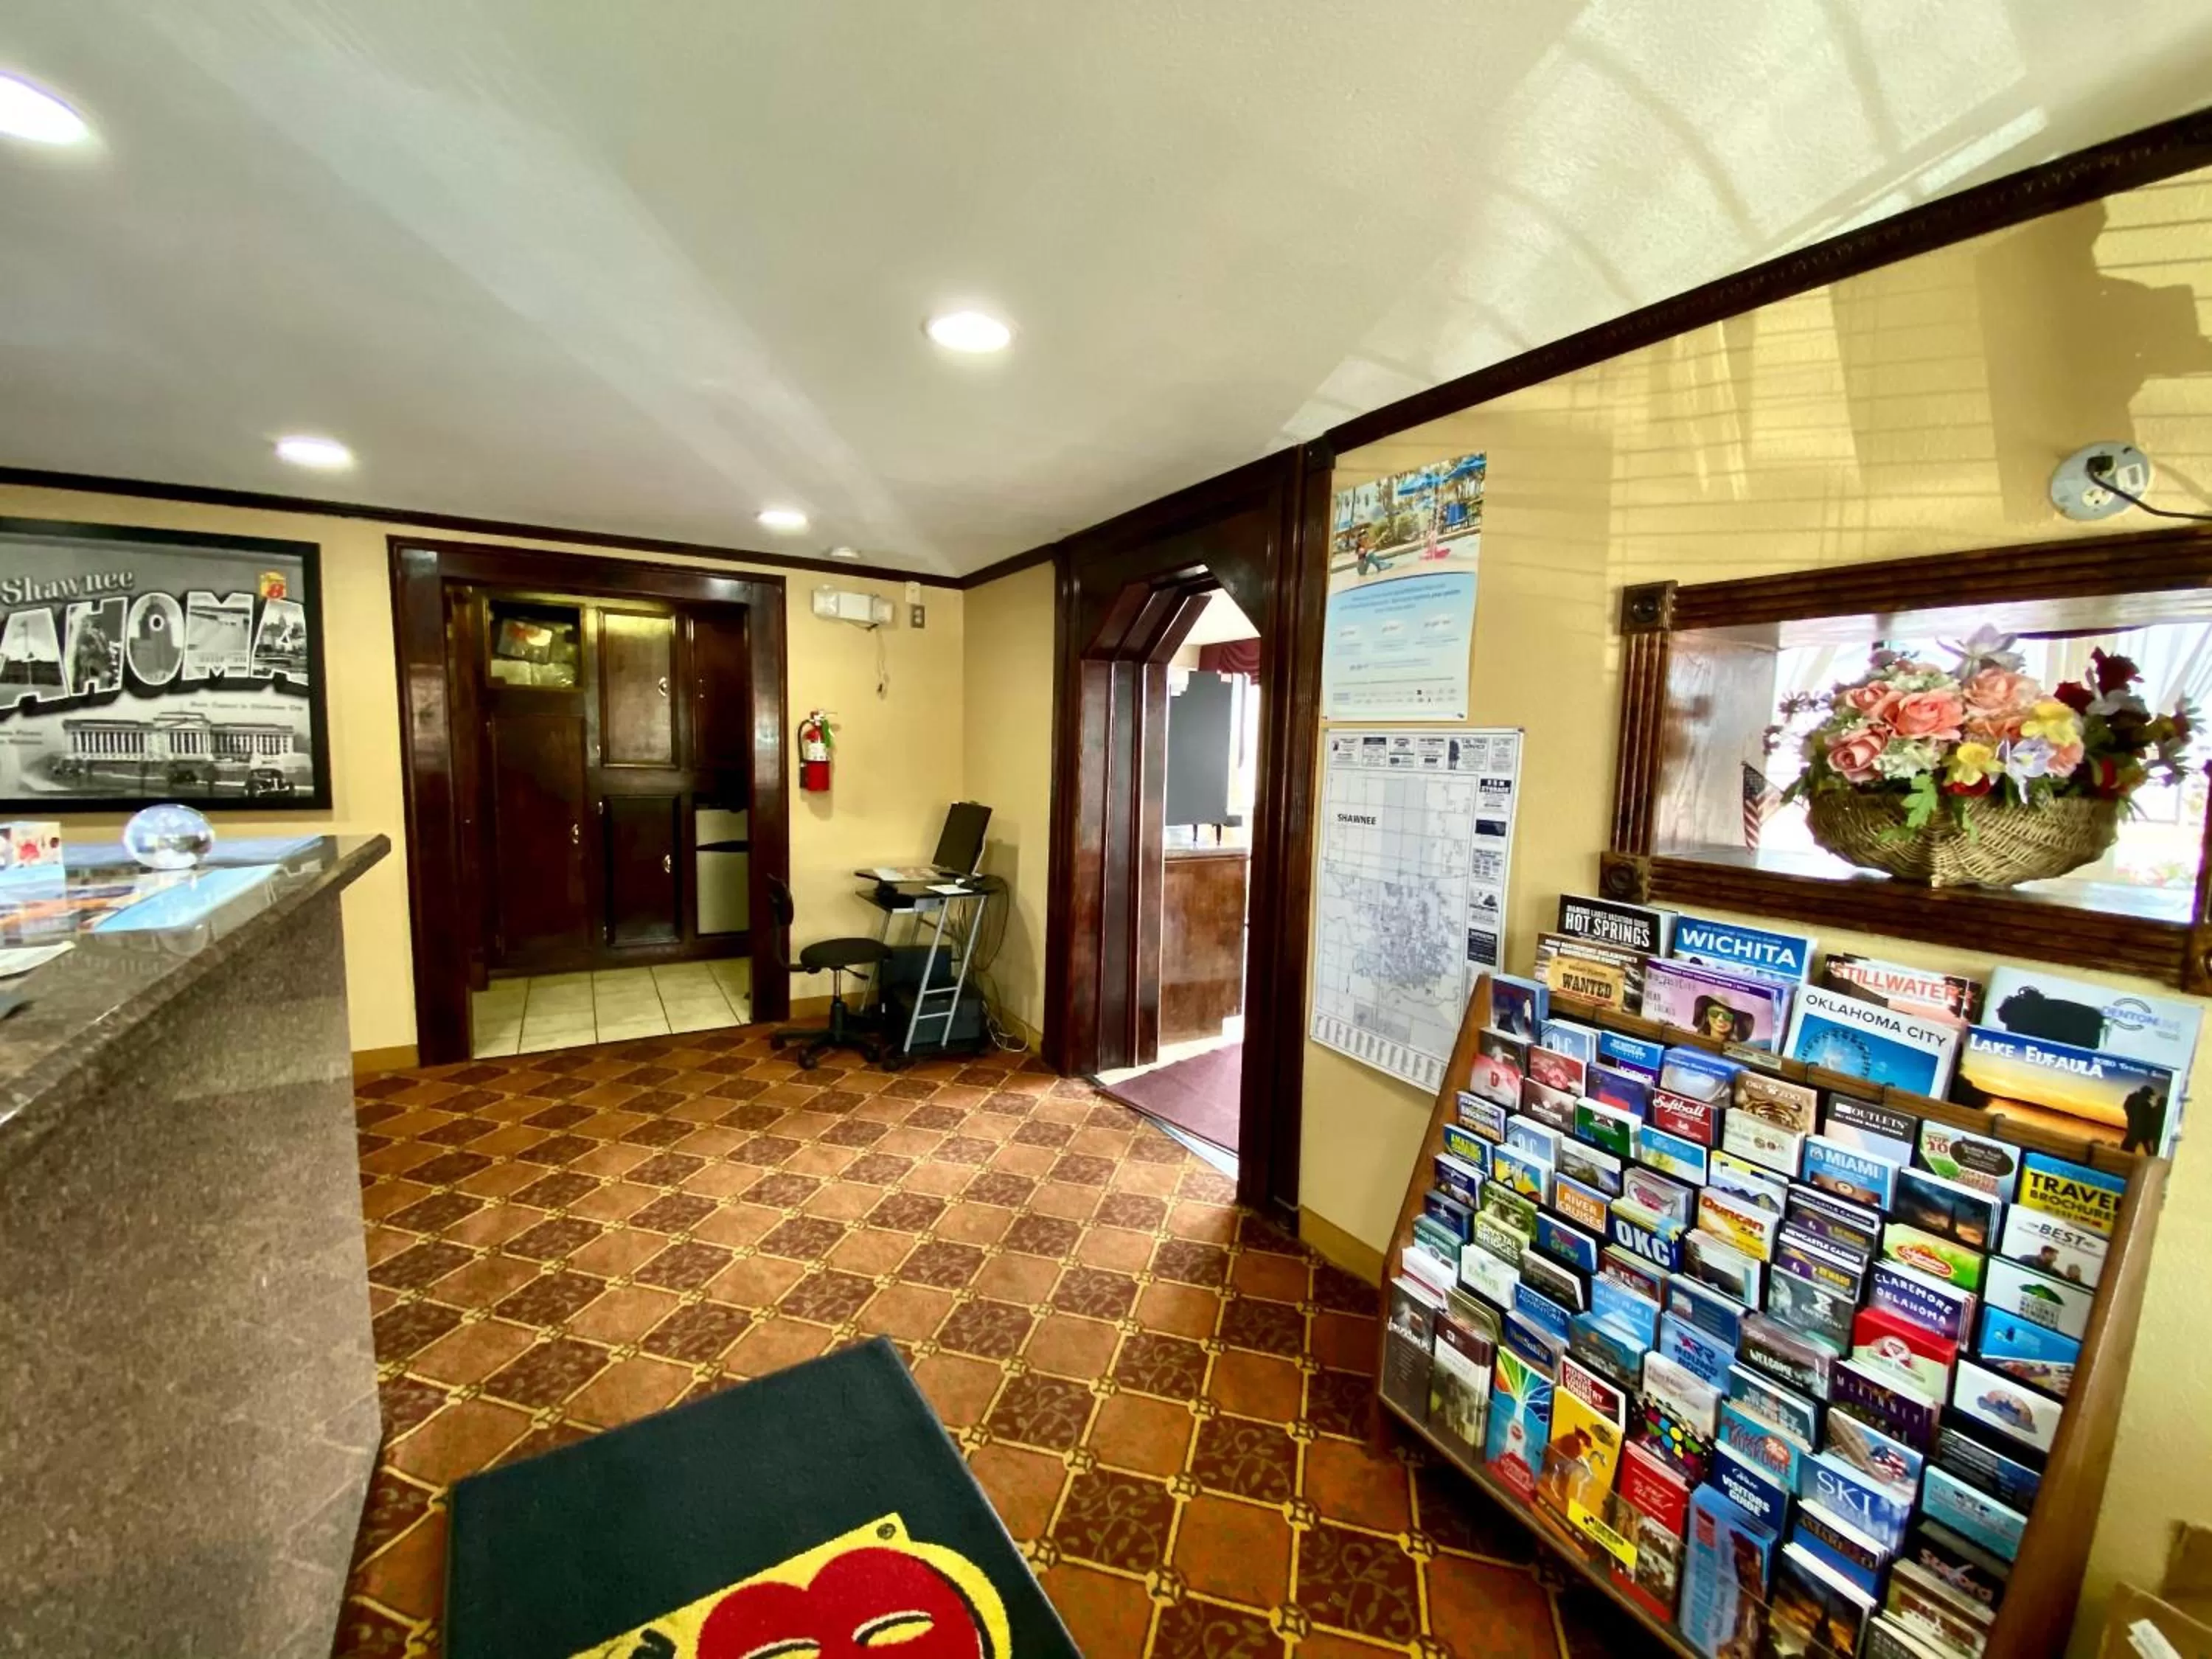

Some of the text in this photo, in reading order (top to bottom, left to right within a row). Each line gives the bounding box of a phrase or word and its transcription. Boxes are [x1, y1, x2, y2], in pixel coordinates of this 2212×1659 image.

[1, 570, 133, 604] Shawnee
[1337, 813, 1377, 825] SHAWNEE
[1565, 912, 1650, 947] HOT SPRINGS
[1682, 928, 1797, 968] WICHITA
[1562, 973, 1613, 998] WANTED
[1830, 961, 1964, 1003] STILLWATER
[1806, 993, 1947, 1048] OKLAHOMA CITY
[1970, 1034, 2104, 1079] LAKE EUFAULA
[1652, 1095, 1705, 1118] Softball
[1826, 1149, 1879, 1178] MIAMI
[1927, 1141, 1948, 1153] 10
[1559, 1199, 1603, 1231] CRUISES
[1564, 1189, 1598, 1214] RIVER
[1701, 1195, 1765, 1232] Duncan
[1477, 1232, 1520, 1261] BRIDGES
[1615, 1220, 1670, 1267] OKC
[1784, 1227, 1860, 1264] NEWCASTLE CASINO
[2038, 1222, 2086, 1245] BEST
[1874, 1273, 1953, 1315] CLAREMORE
[1877, 1287, 1947, 1326] OKLAHOMA
[1565, 1365, 1593, 1386] HORSE
[1674, 1344, 1718, 1377] ROUND
[1677, 1357, 1713, 1384] ROCK
[1565, 1374, 1604, 1403] COUNTRY
[1722, 1473, 1770, 1513] VISITORS
[1729, 1488, 1761, 1517] GUIDE
[1815, 1469, 1873, 1517] SKI
